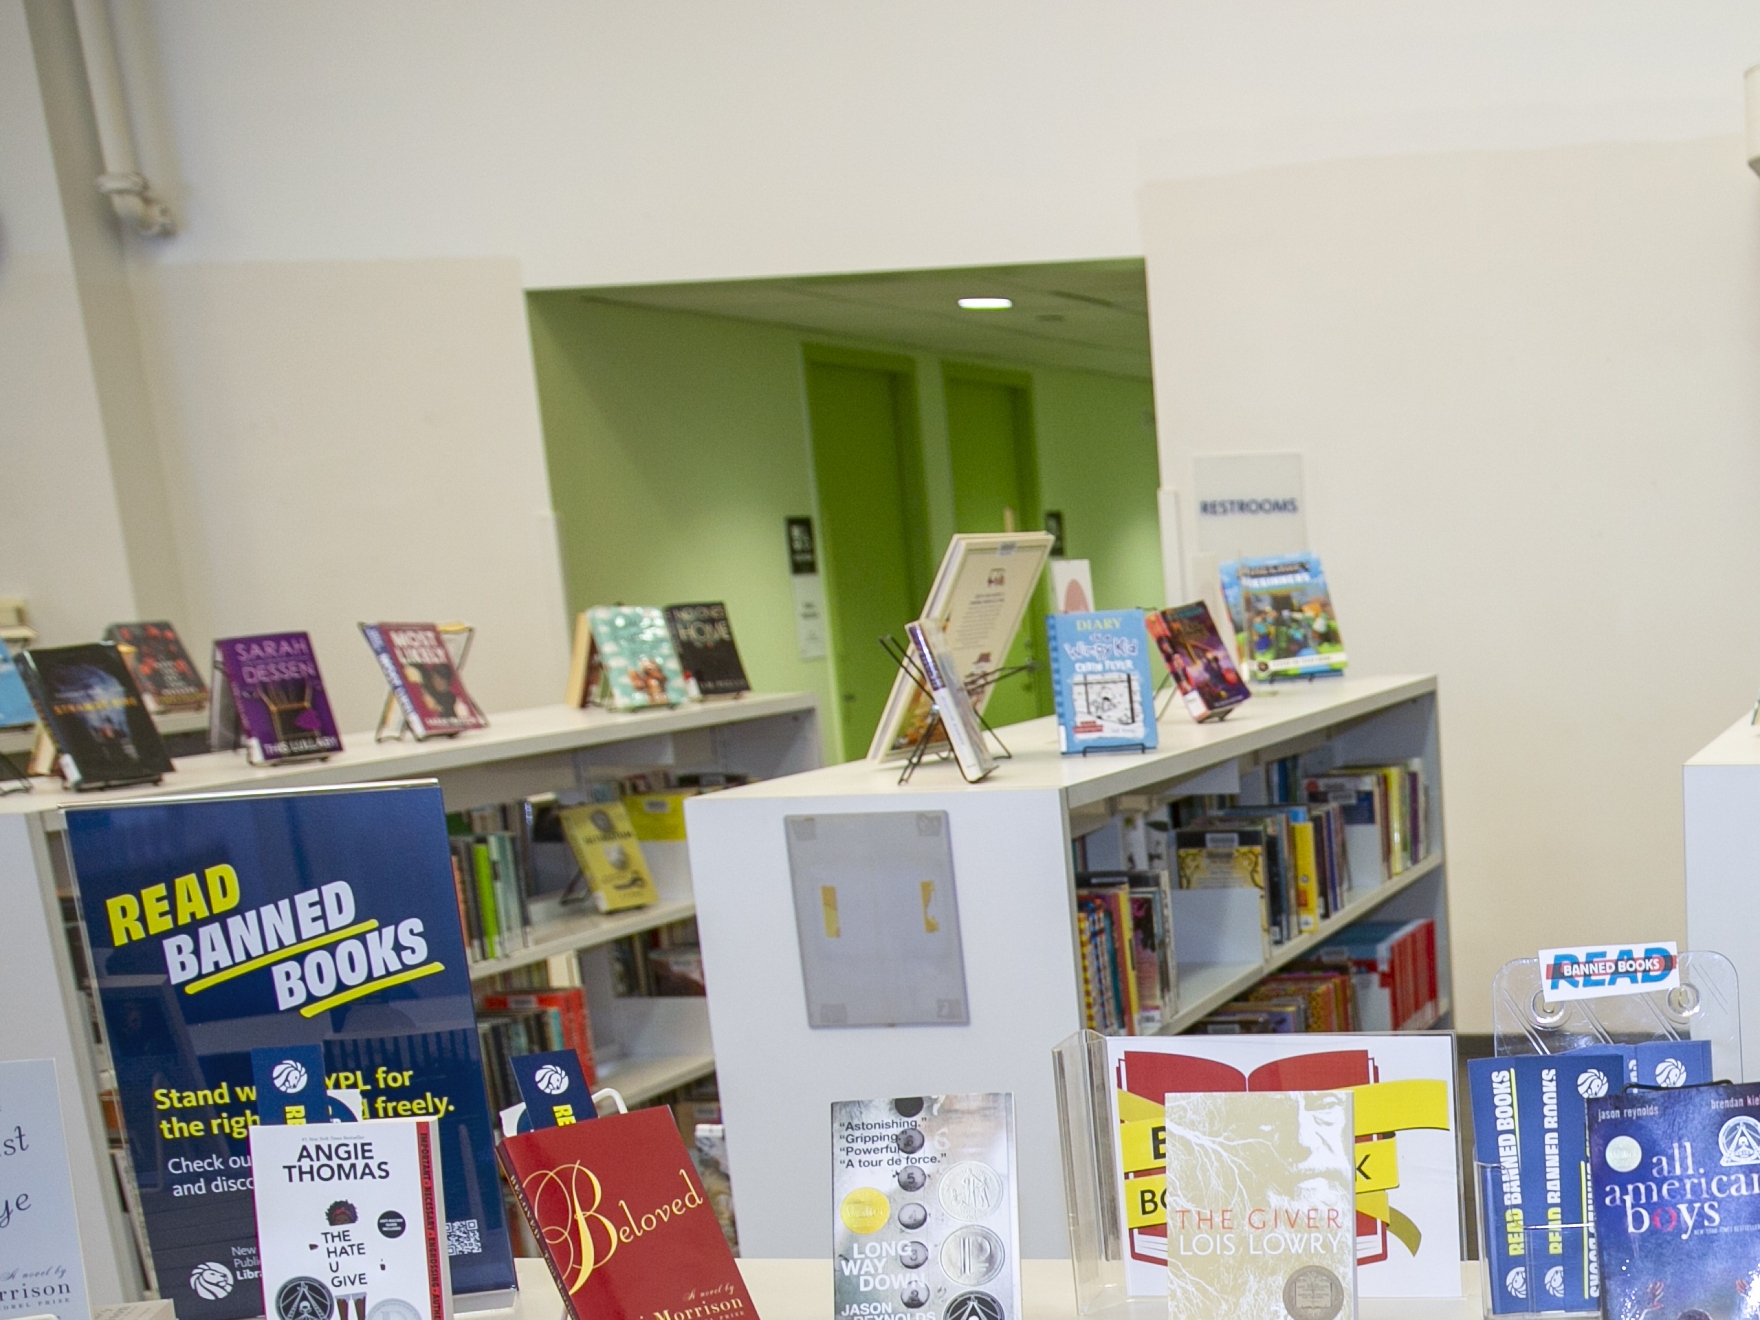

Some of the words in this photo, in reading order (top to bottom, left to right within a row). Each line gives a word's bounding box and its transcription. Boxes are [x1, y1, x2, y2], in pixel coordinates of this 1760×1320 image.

[1199, 498, 1298, 515] RESTROOMS
[1076, 617, 1122, 632] DIARY
[235, 636, 307, 662] SARAH
[391, 629, 436, 649] MOST
[241, 661, 316, 686] DESSEN
[106, 863, 241, 947] READ
[162, 880, 356, 985] BANNED
[271, 917, 429, 1011] BOOKS
[1550, 947, 1673, 990] READ
[1564, 962, 1615, 977] BANNED
[1618, 958, 1660, 973] BOOKS
[376, 1067, 413, 1089] for
[154, 1082, 230, 1111] Stand
[375, 1092, 455, 1120] freely.
[1492, 1070, 1515, 1131] BOOKS
[1598, 1109, 1620, 1122] jason
[1624, 1105, 1659, 1119] reynolds
[1711, 1097, 1744, 1110] brendan
[159, 1117, 205, 1140] the
[297, 1142, 374, 1162] ANGIE
[419, 1132, 431, 1181] IMPORTANT
[858, 1159, 883, 1168] tour
[887, 1157, 902, 1166] de
[1652, 1142, 1694, 1178] all
[168, 1154, 224, 1174] Check
[283, 1161, 390, 1182] THOMAS
[173, 1178, 206, 1196] and
[425, 1187, 437, 1231] NECESSARY
[1175, 1209, 1233, 1231] THE
[1247, 1208, 1342, 1230] GIVER
[1622, 1195, 1720, 1240] boys
[321, 1230, 352, 1244] THE
[522, 1159, 703, 1295] Beloved
[231, 1247, 256, 1256] New
[326, 1243, 366, 1258] HATE
[853, 1240, 912, 1259] LONG
[1179, 1234, 1236, 1256] LOIS
[1249, 1232, 1342, 1256] LOWRY
[329, 1262, 339, 1273] U
[428, 1237, 439, 1289] ENGROSSING
[841, 1258, 887, 1276] WAY
[331, 1273, 368, 1288] GIVE
[860, 1273, 925, 1291] DOWN
[38, 1298, 70, 1306] PRIZE
[841, 1302, 892, 1316] JASON
[719, 1310, 745, 1320] PRIZE
